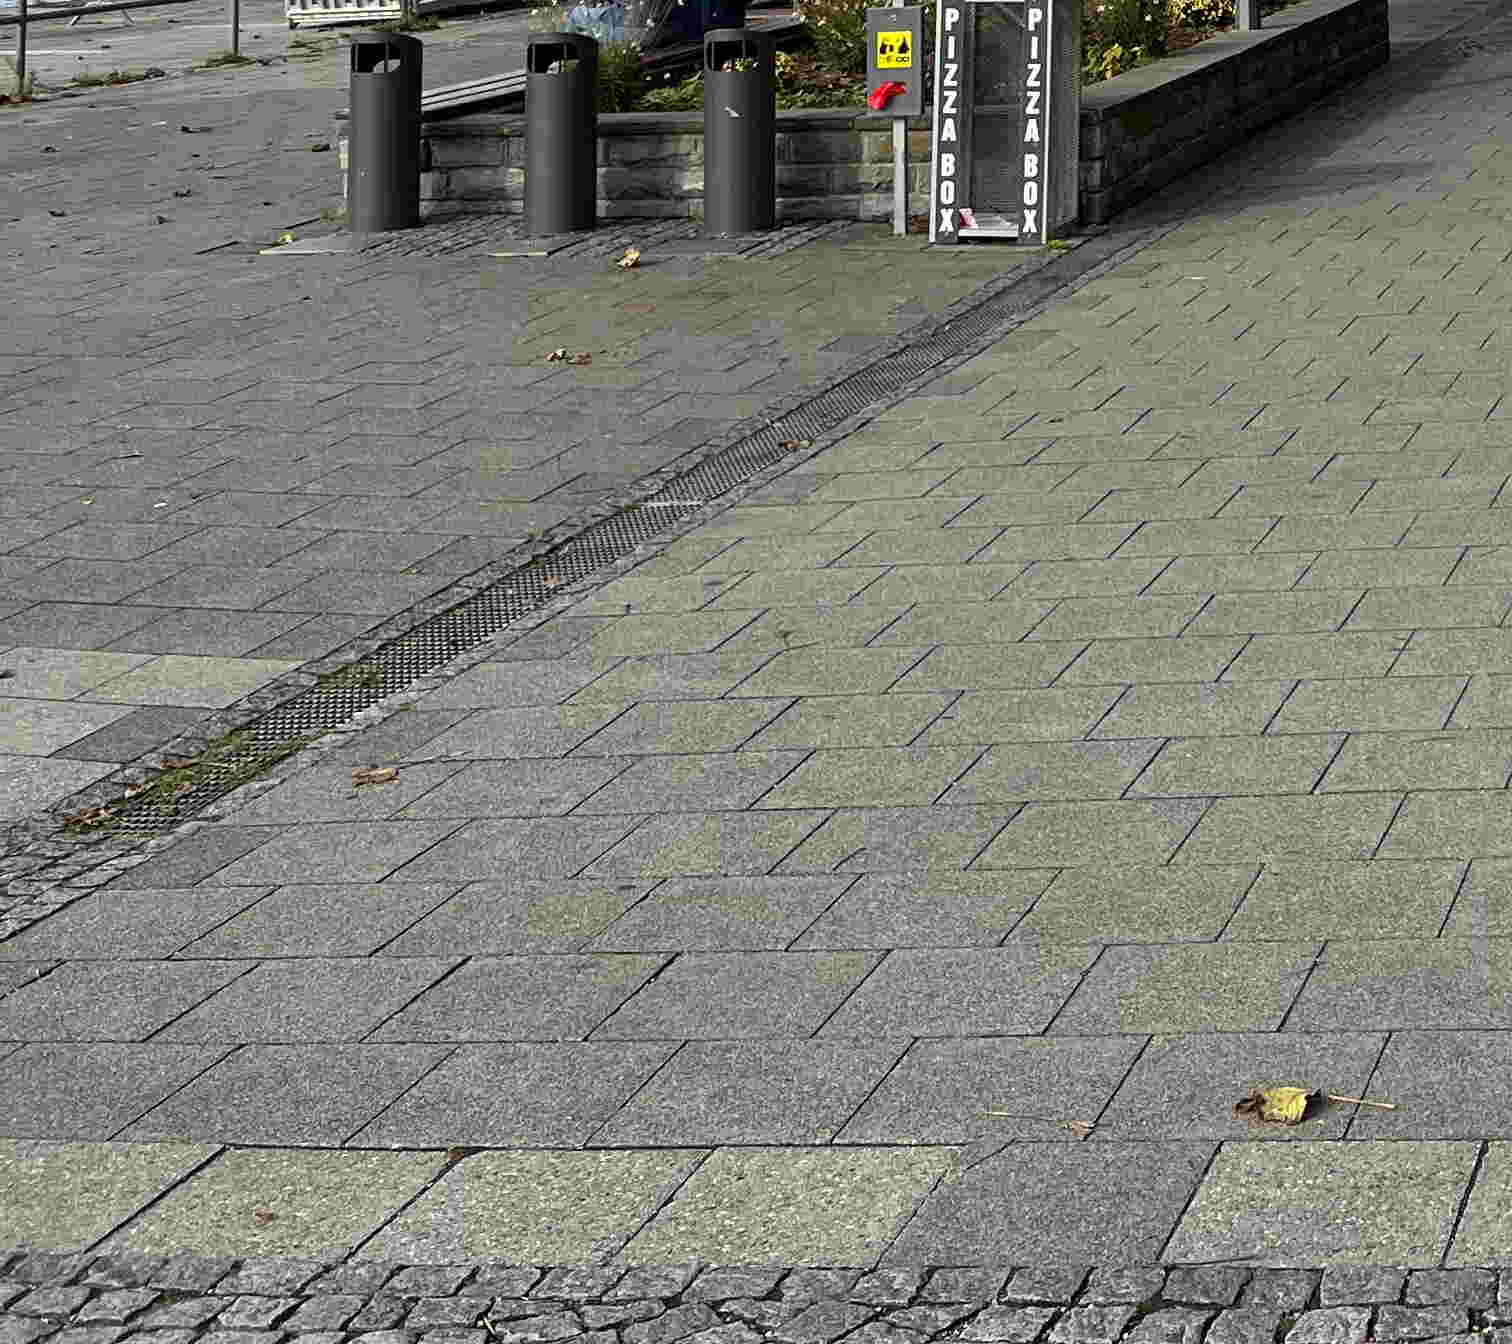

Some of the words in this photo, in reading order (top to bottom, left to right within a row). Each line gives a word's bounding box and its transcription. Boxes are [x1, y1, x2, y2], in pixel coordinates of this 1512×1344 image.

[940, 8, 960, 142] PIZZA
[1023, 8, 1043, 142] PIZZA
[938, 153, 957, 233] BOX
[1021, 153, 1039, 233] BOX
